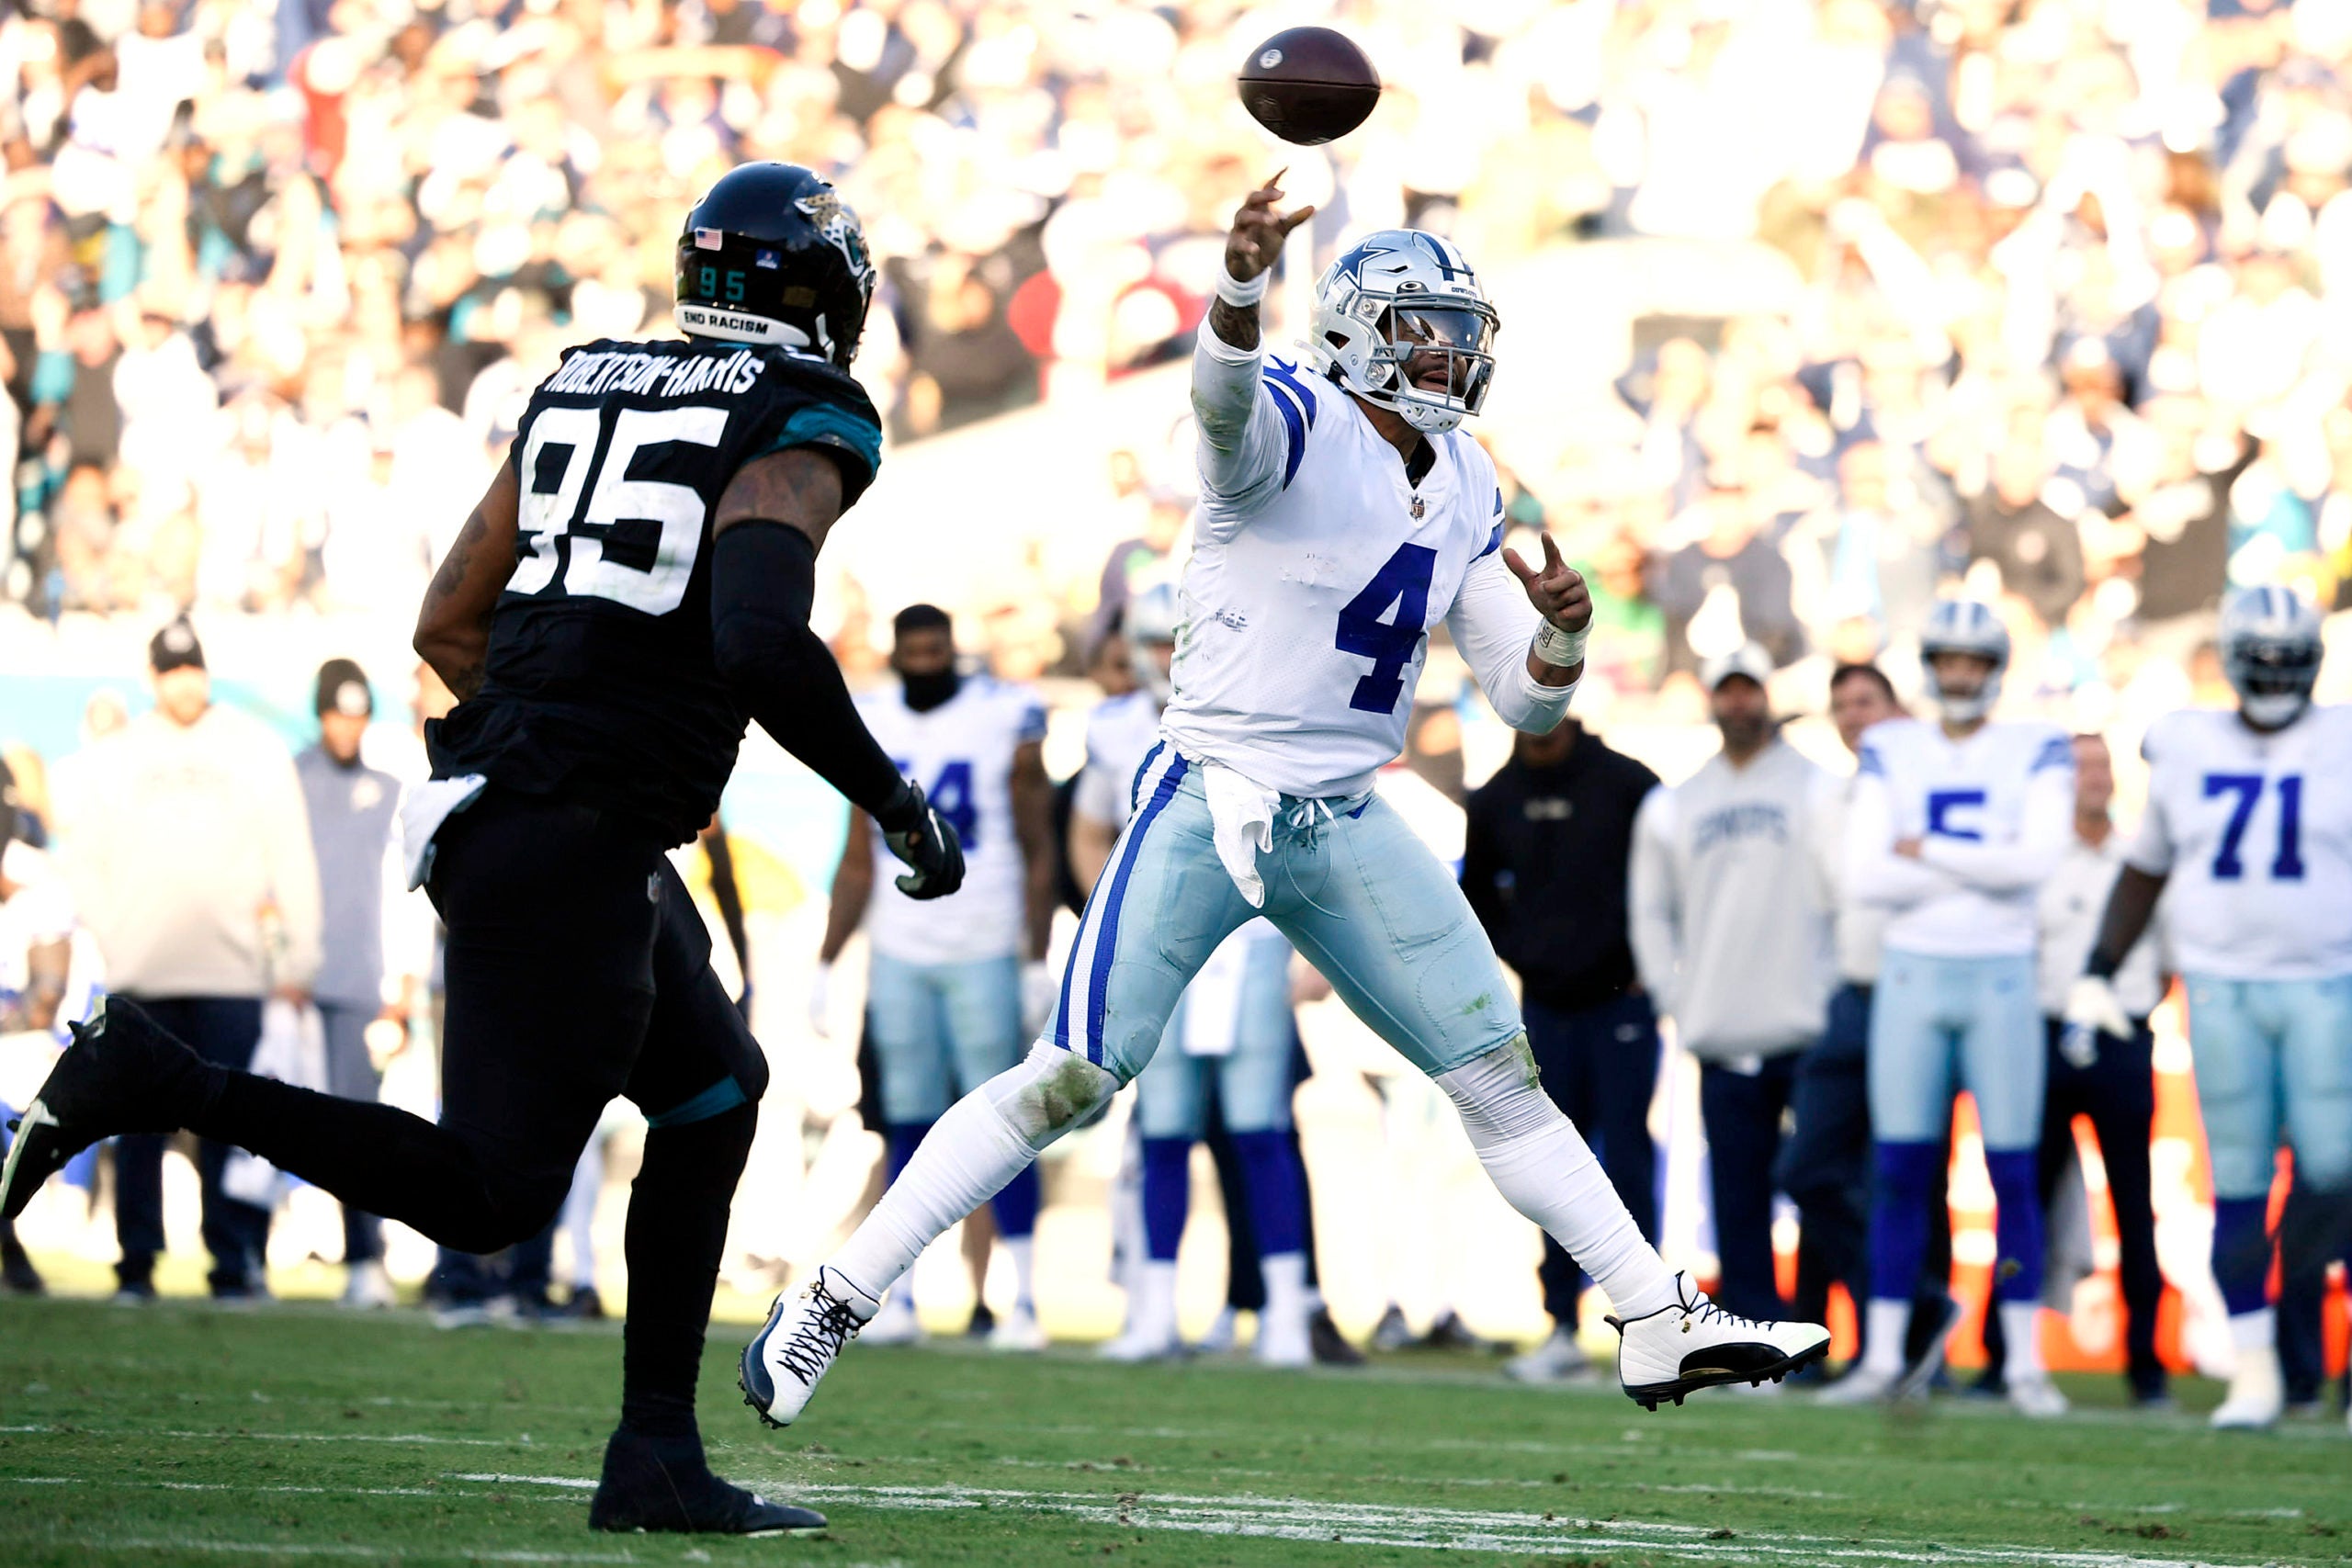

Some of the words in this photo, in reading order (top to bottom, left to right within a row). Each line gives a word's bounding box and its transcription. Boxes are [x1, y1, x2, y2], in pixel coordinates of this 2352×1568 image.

[684, 311, 706, 325] END
[708, 312, 769, 335] RACISM
[699, 266, 745, 301] 95
[504, 406, 730, 616] 95
[1335, 541, 1439, 715] 4
[891, 761, 978, 851] 4
[2201, 772, 2306, 881] 71
